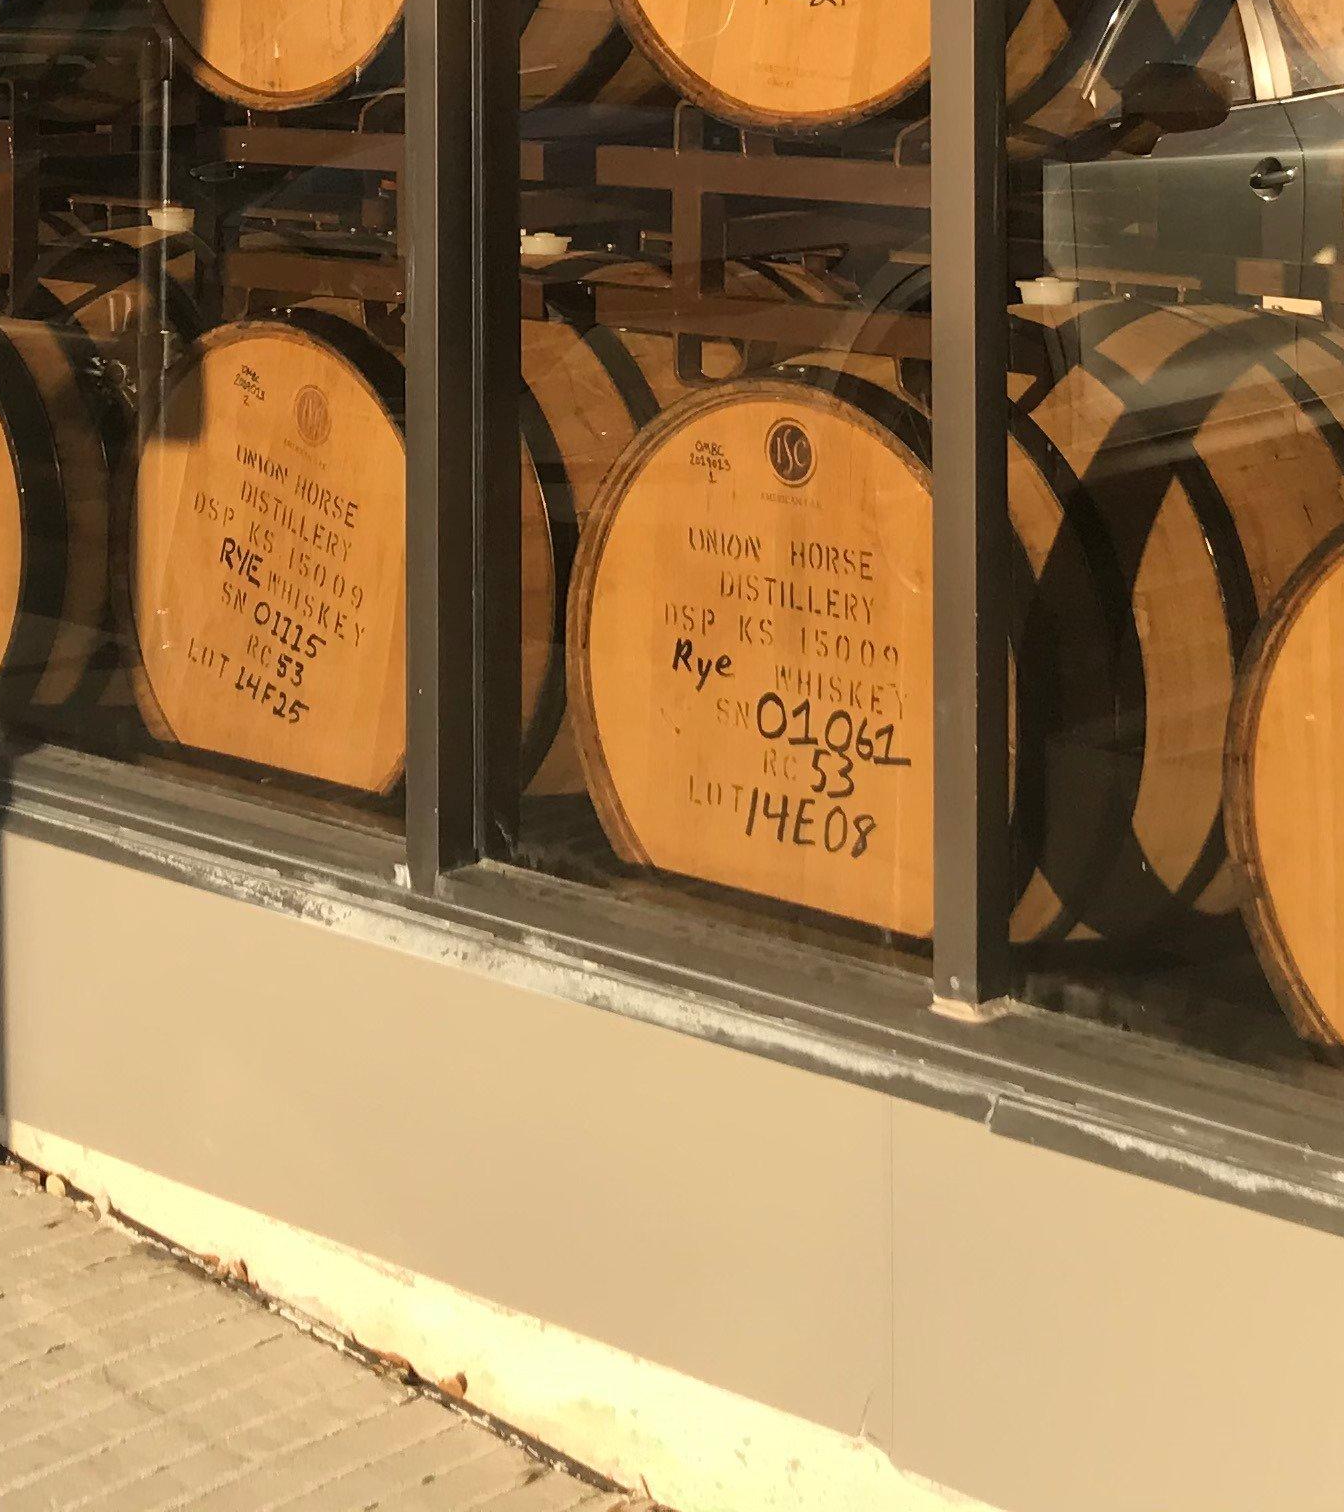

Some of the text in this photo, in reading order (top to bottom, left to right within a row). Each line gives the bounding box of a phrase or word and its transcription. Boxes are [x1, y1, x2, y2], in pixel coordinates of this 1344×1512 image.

[695, 440, 724, 456] OMBC
[776, 429, 805, 474] ISC
[237, 444, 289, 484] UNION
[295, 475, 358, 529] HORSE
[241, 480, 352, 562] DISTILLERY
[194, 491, 363, 609] DSP KS 15009
[688, 527, 874, 581] UNION HORSE
[220, 538, 364, 647] RYE WHISKEY
[222, 581, 326, 659] SN 01115
[720, 571, 874, 625] DISTILLERY
[247, 634, 304, 687] RC 53
[665, 602, 898, 668] DSP KS 15009
[188, 638, 309, 724] LOT 14F25
[672, 638, 908, 719] Rye WHISKEY
[716, 692, 911, 767] SN 01061
[763, 748, 854, 798] RC 53
[690, 775, 877, 859] LOT 14E08
